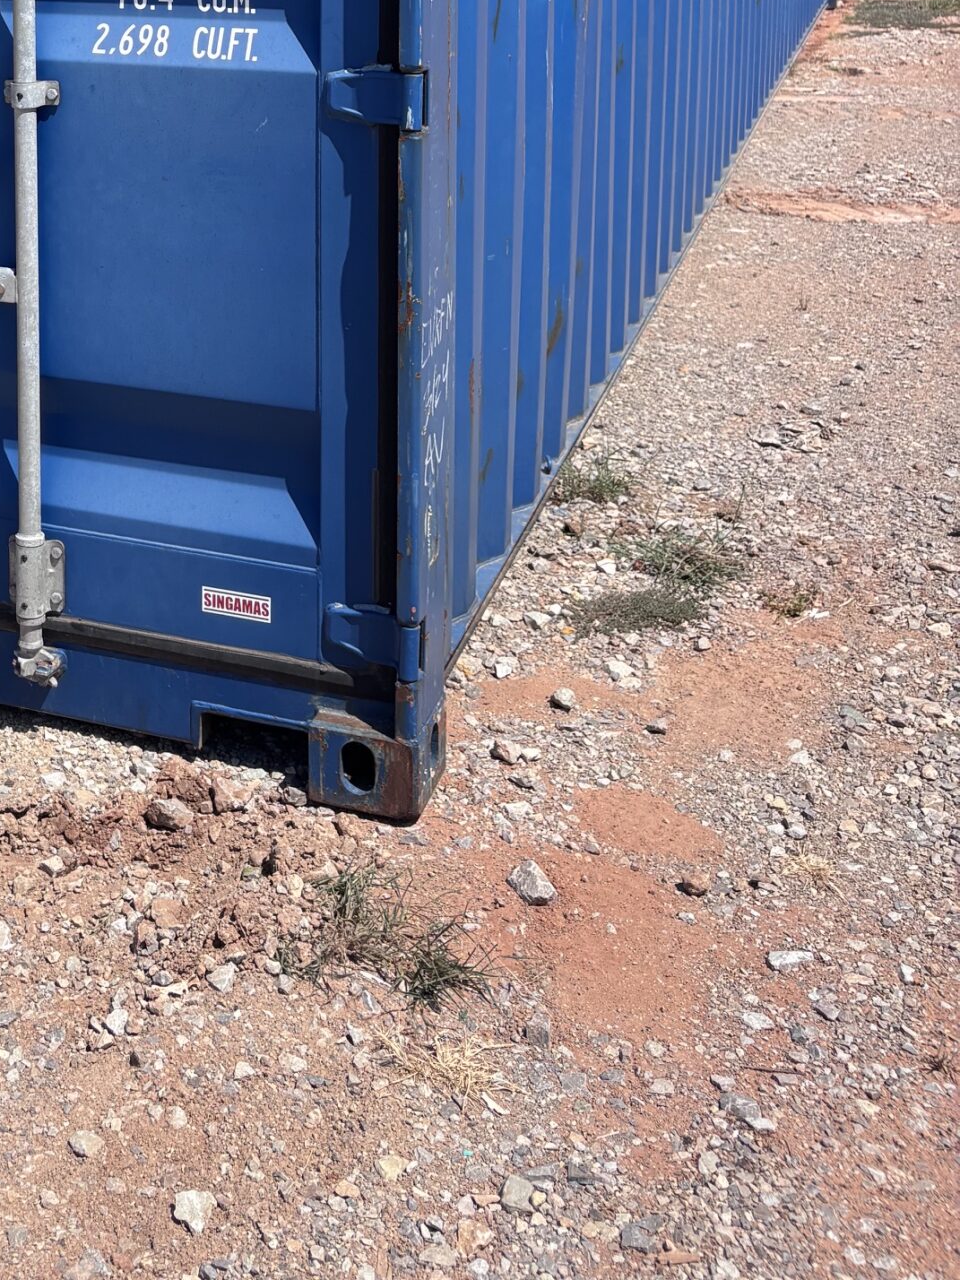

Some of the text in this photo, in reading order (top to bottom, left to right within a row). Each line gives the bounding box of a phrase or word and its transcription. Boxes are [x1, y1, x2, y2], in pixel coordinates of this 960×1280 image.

[92, 22, 258, 62] 2,698 CU.FT.
[204, 593, 269, 617] SINGAMAS
